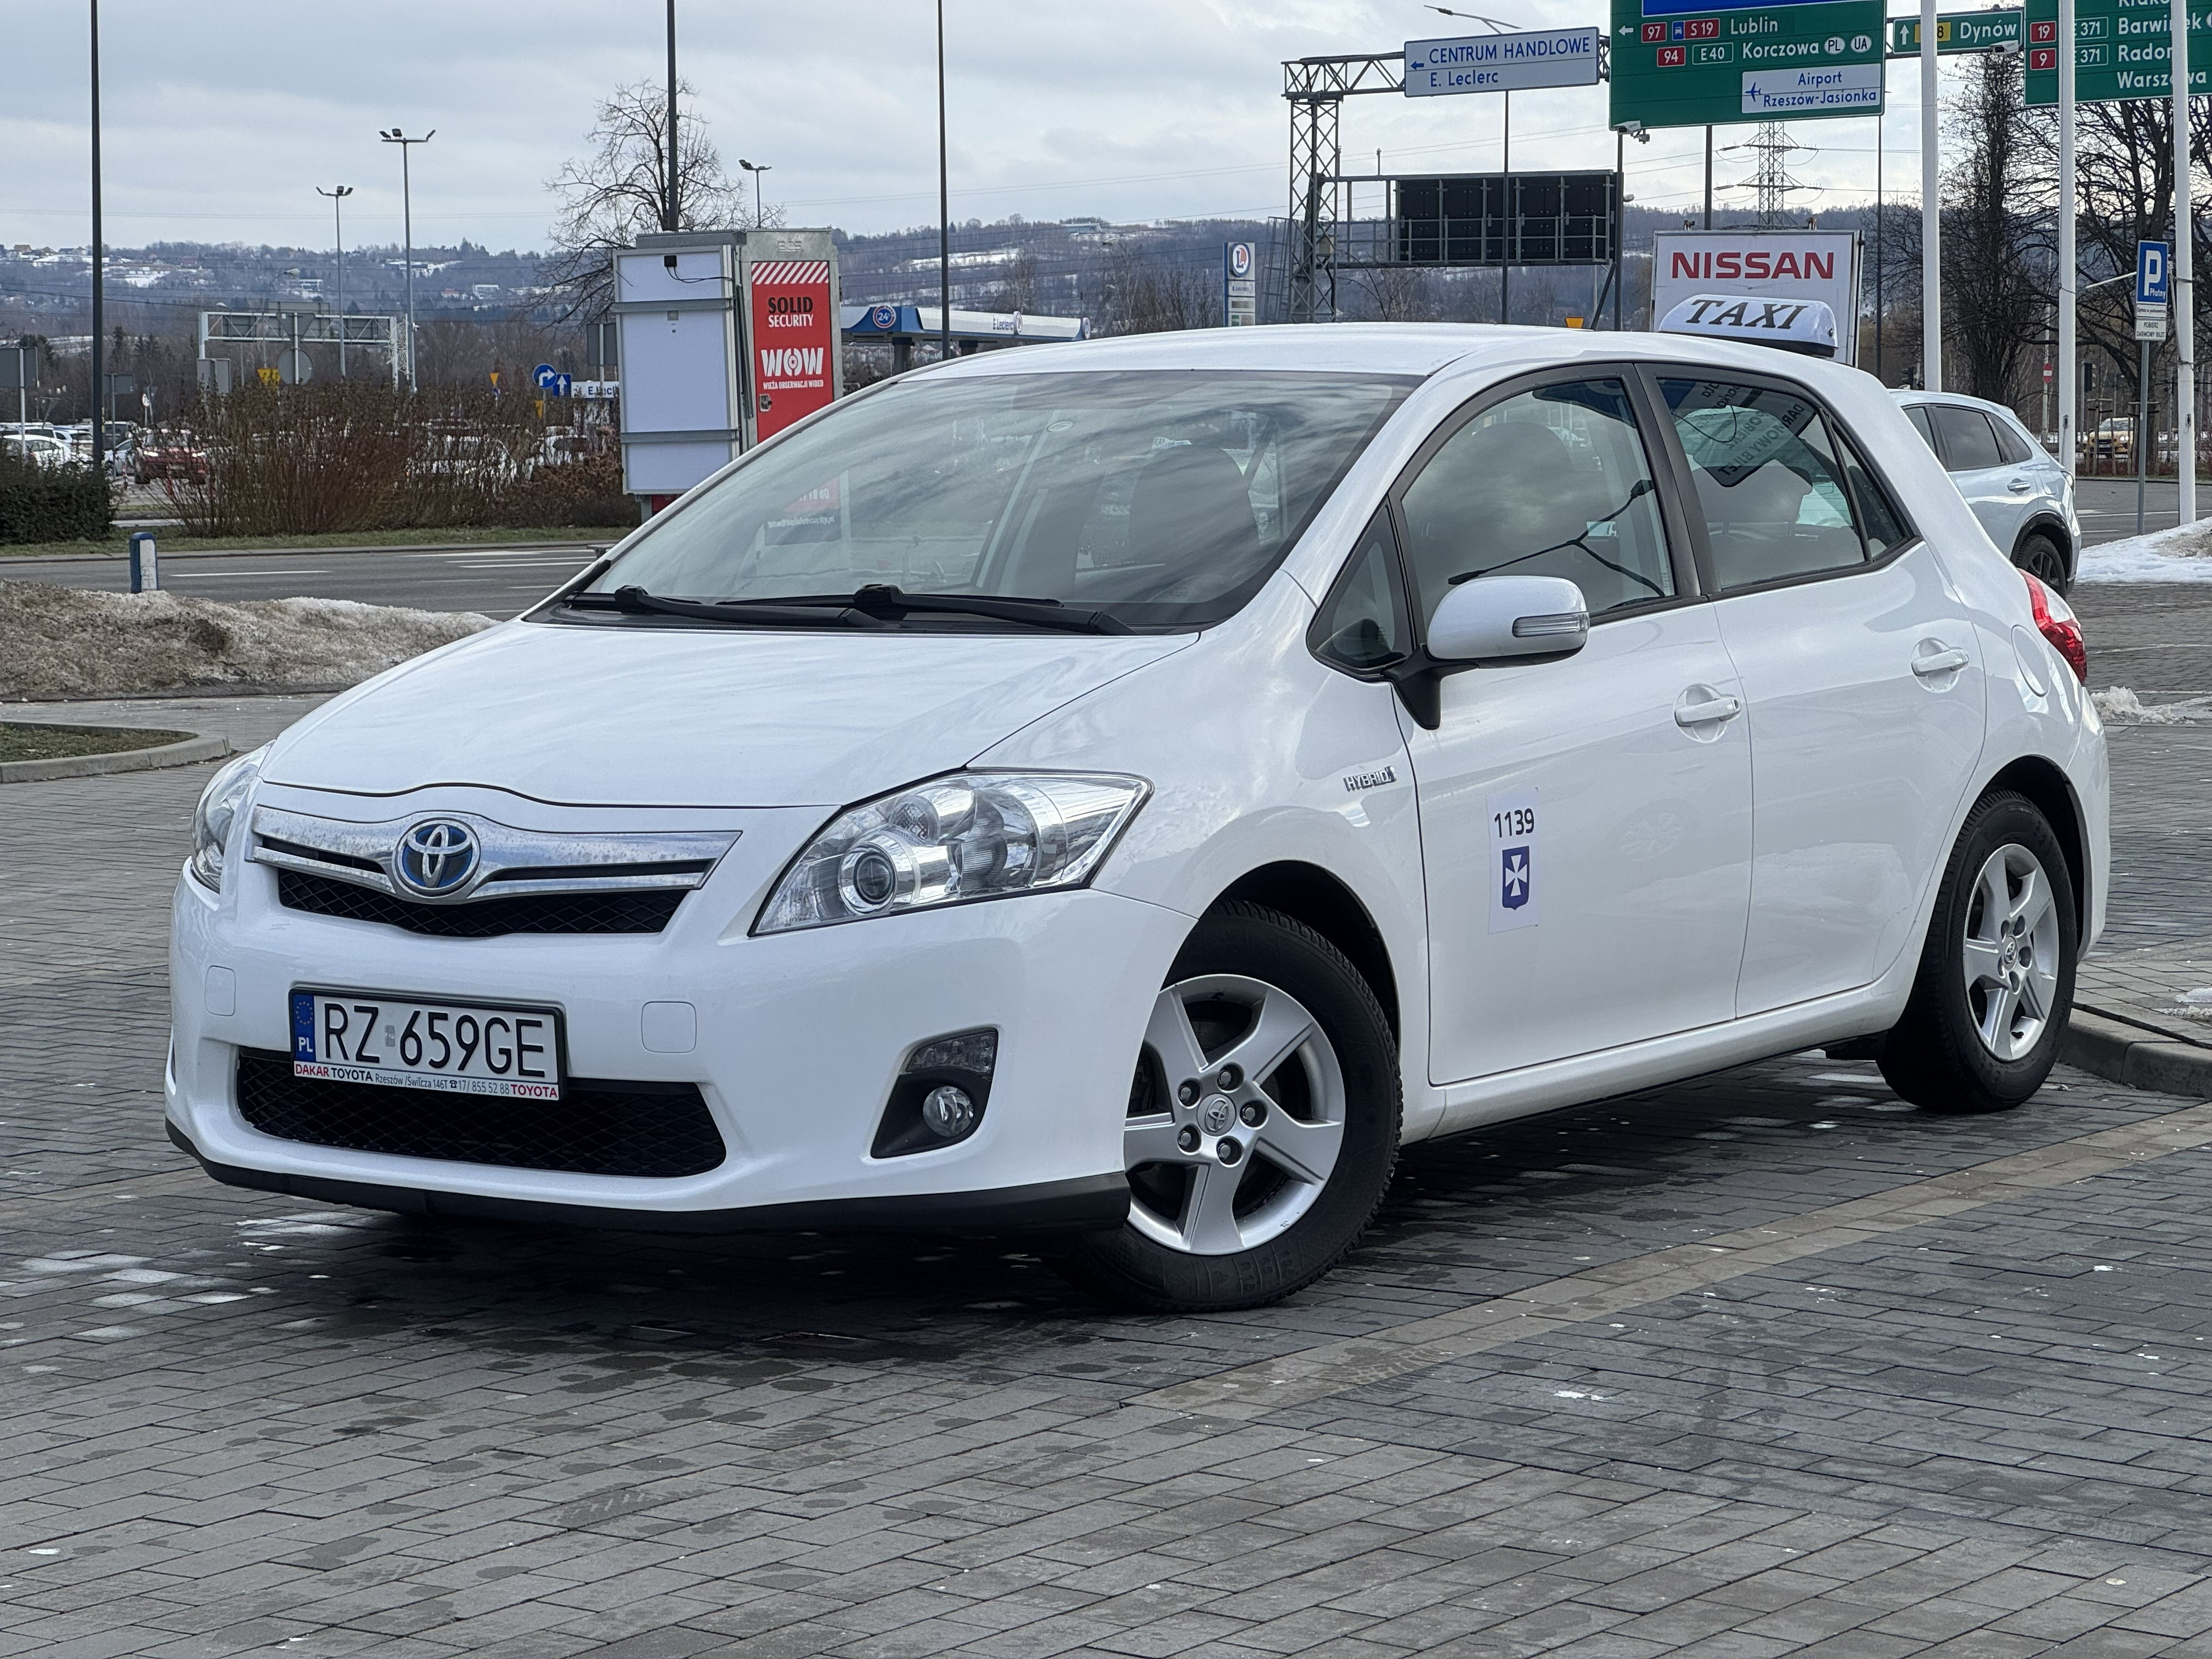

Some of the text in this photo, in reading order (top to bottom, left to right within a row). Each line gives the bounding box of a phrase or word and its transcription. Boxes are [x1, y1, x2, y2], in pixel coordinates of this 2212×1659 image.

[1730, 17, 1779, 36] Lublin
[1960, 20, 2017, 43] Dynów
[2118, 12, 2202, 35] Barwik
[1647, 26, 1661, 39] 97
[2038, 25, 2051, 40] 19
[1429, 37, 1590, 64] CENTRUM HANDLOWE
[1742, 42, 1819, 59] Korczowa
[1828, 39, 1842, 52] PL
[1854, 38, 1867, 50] UA
[1664, 50, 1679, 64] 94
[2039, 52, 2047, 66] 9
[1430, 70, 1499, 87] E. Leclerc
[1798, 71, 1842, 88] Airport
[1763, 89, 1877, 108] Rzeszów-Jasionka
[1672, 252, 1834, 279] NISSAN
[768, 297, 814, 314] SOLID
[768, 314, 814, 328] SECURITY
[1685, 299, 1809, 330] TAXI
[761, 347, 824, 377] WOW
[763, 380, 824, 390] WIEŻA OBSERWACJI WIDEO
[1344, 769, 1390, 792] HYBRID
[1494, 808, 1535, 838] 1139
[298, 1036, 313, 1053] PL
[324, 1003, 545, 1078] RZ 659GE
[295, 1064, 330, 1077] DAKAR
[331, 1067, 374, 1082] TOYOTA
[375, 1073, 403, 1086] Rzeszów
[472, 1080, 487, 1092] 855
[488, 1082, 498, 1094] 52
[500, 1082, 510, 1095] 88
[510, 1084, 558, 1098] TOYOTA
